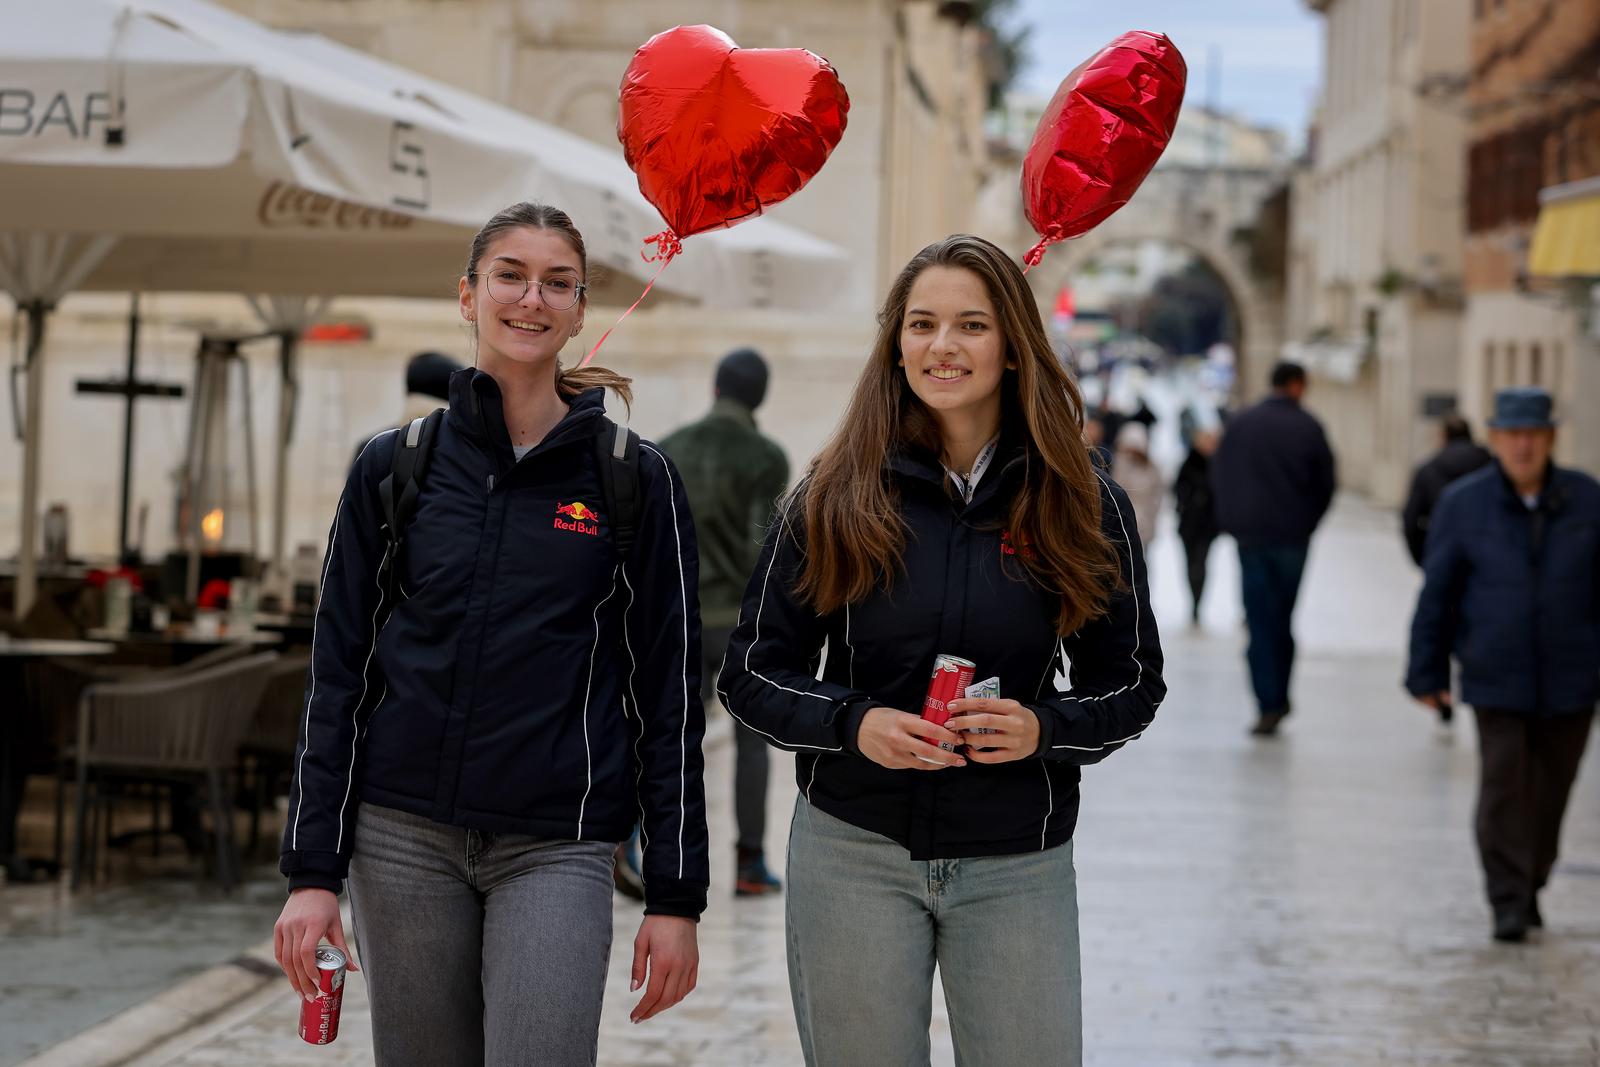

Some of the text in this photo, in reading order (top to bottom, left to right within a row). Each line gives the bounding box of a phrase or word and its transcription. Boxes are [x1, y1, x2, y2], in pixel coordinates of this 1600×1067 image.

[554, 518, 598, 536] Red Bull
[318, 1013, 330, 1045] Red Bull
